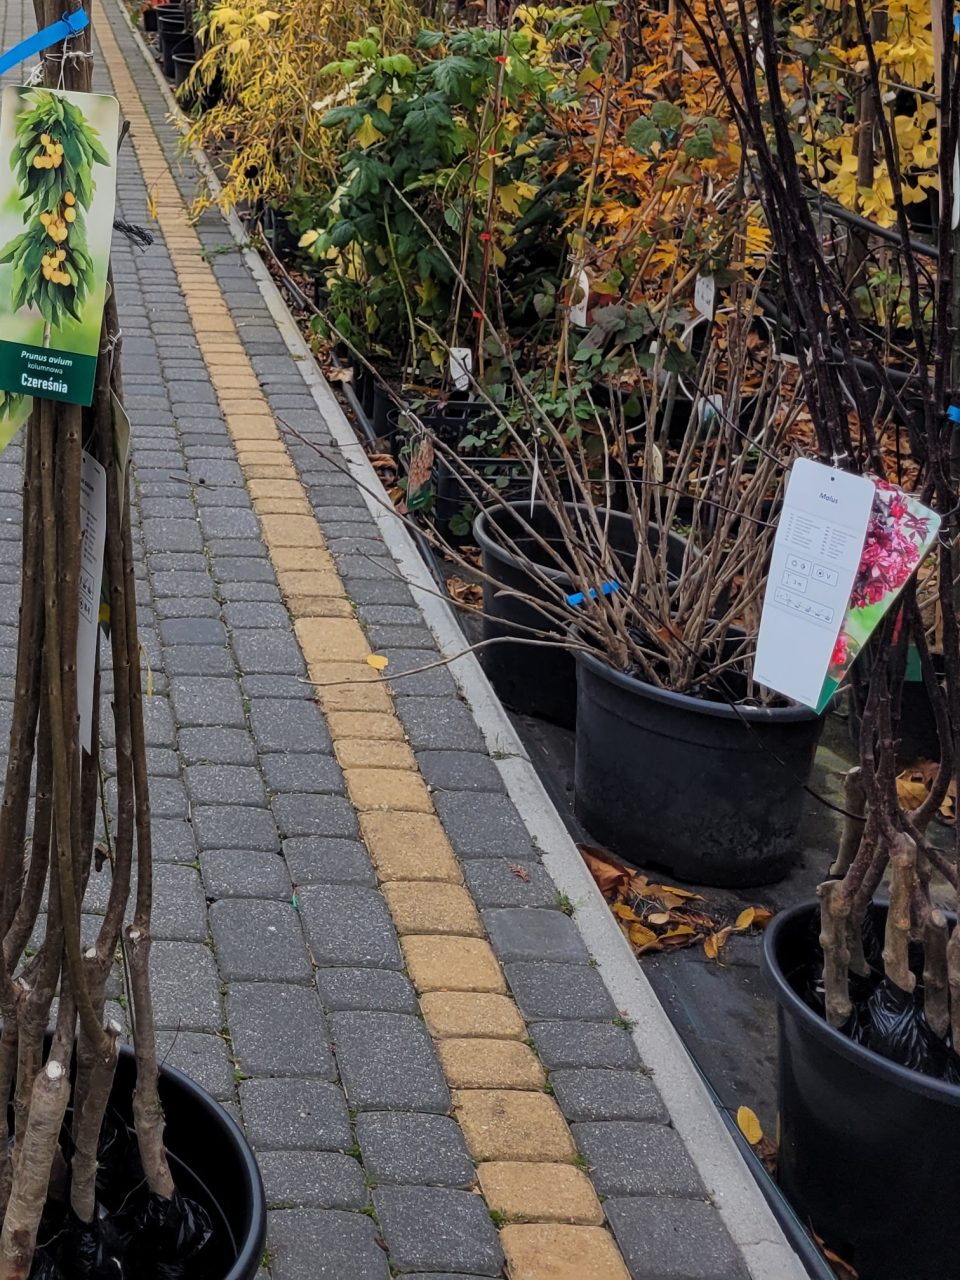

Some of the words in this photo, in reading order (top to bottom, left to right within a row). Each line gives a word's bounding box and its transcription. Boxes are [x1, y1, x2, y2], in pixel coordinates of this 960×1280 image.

[20, 350, 47, 362] Prunus
[48, 356, 73, 367] avium
[27, 362, 64, 375] kolumnowa
[21, 373, 68, 394] Czereśnia
[819, 492, 839, 504] Malus
